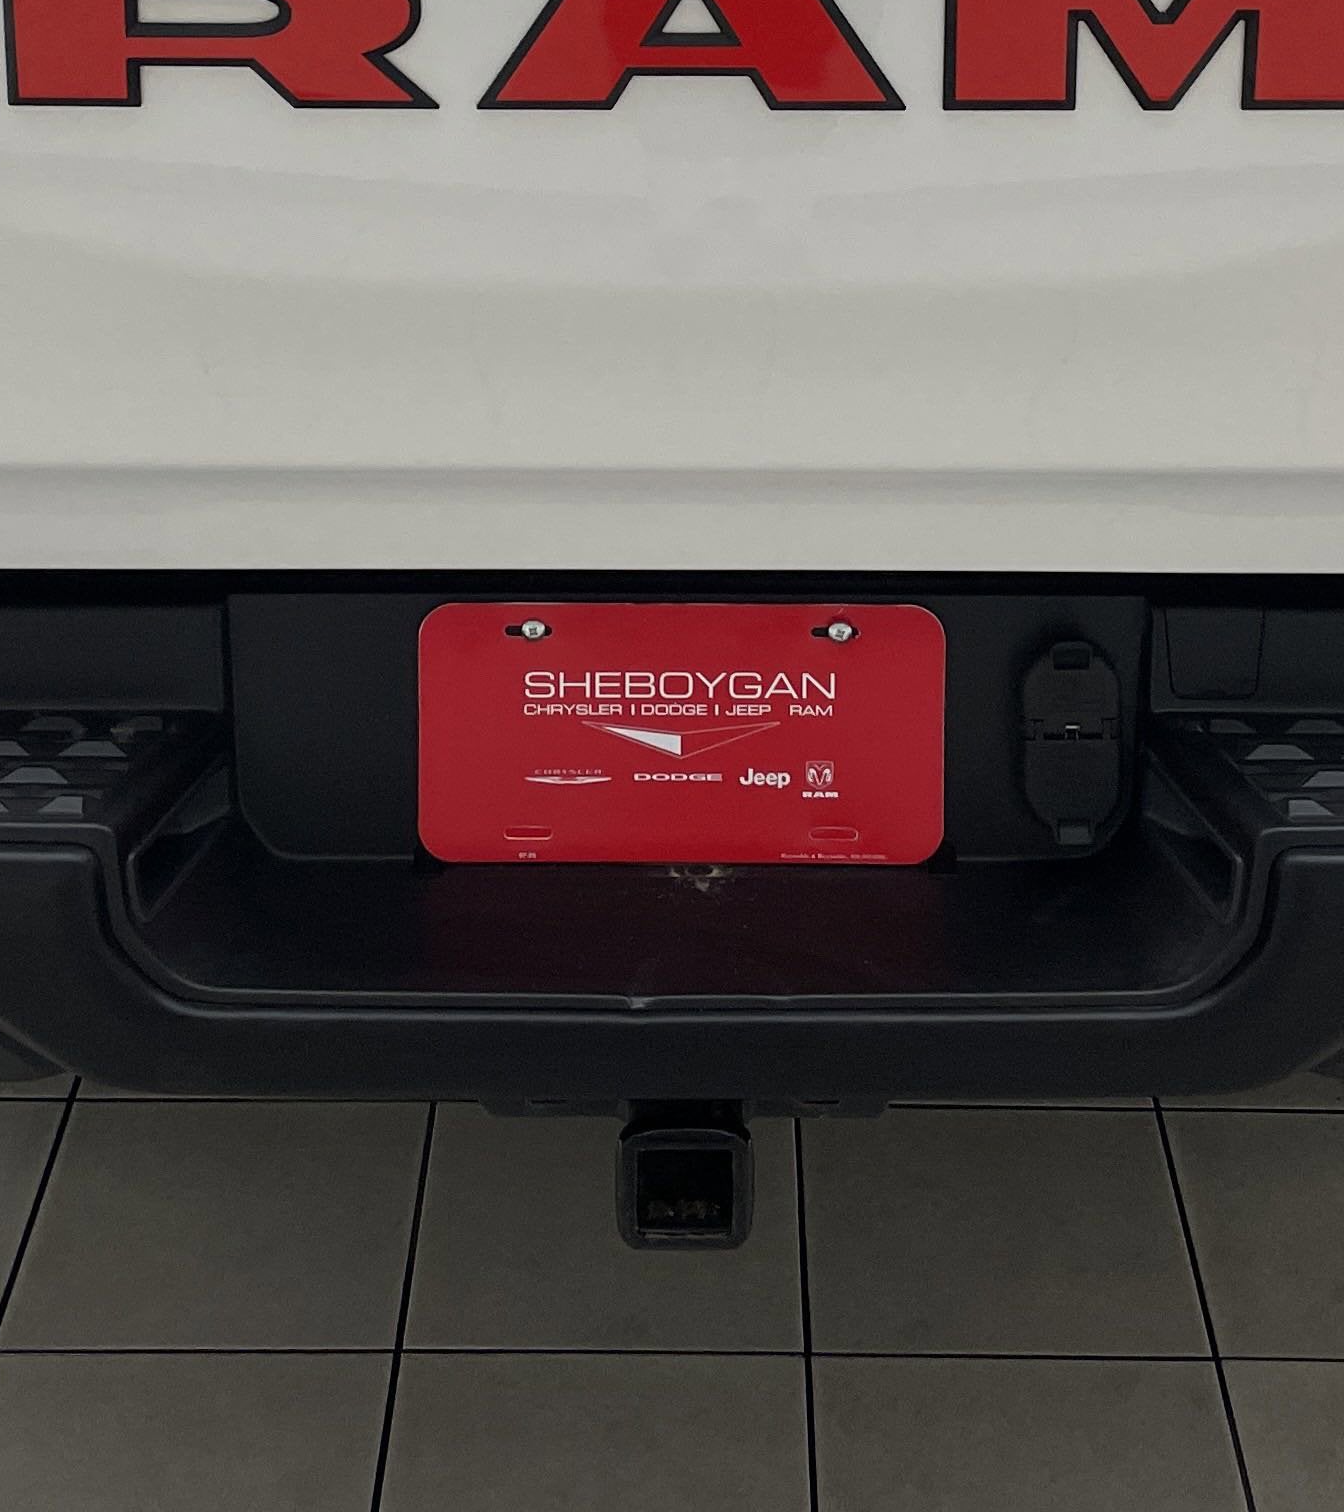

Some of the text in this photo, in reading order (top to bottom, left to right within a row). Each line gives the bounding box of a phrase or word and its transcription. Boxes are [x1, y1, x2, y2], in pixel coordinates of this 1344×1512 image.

[524, 671, 836, 700] SHEBOYGAN
[523, 703, 833, 716] CHRYSLER DODGE JEEP RAM
[633, 772, 723, 782] DODGE
[739, 768, 791, 788] Jeep
